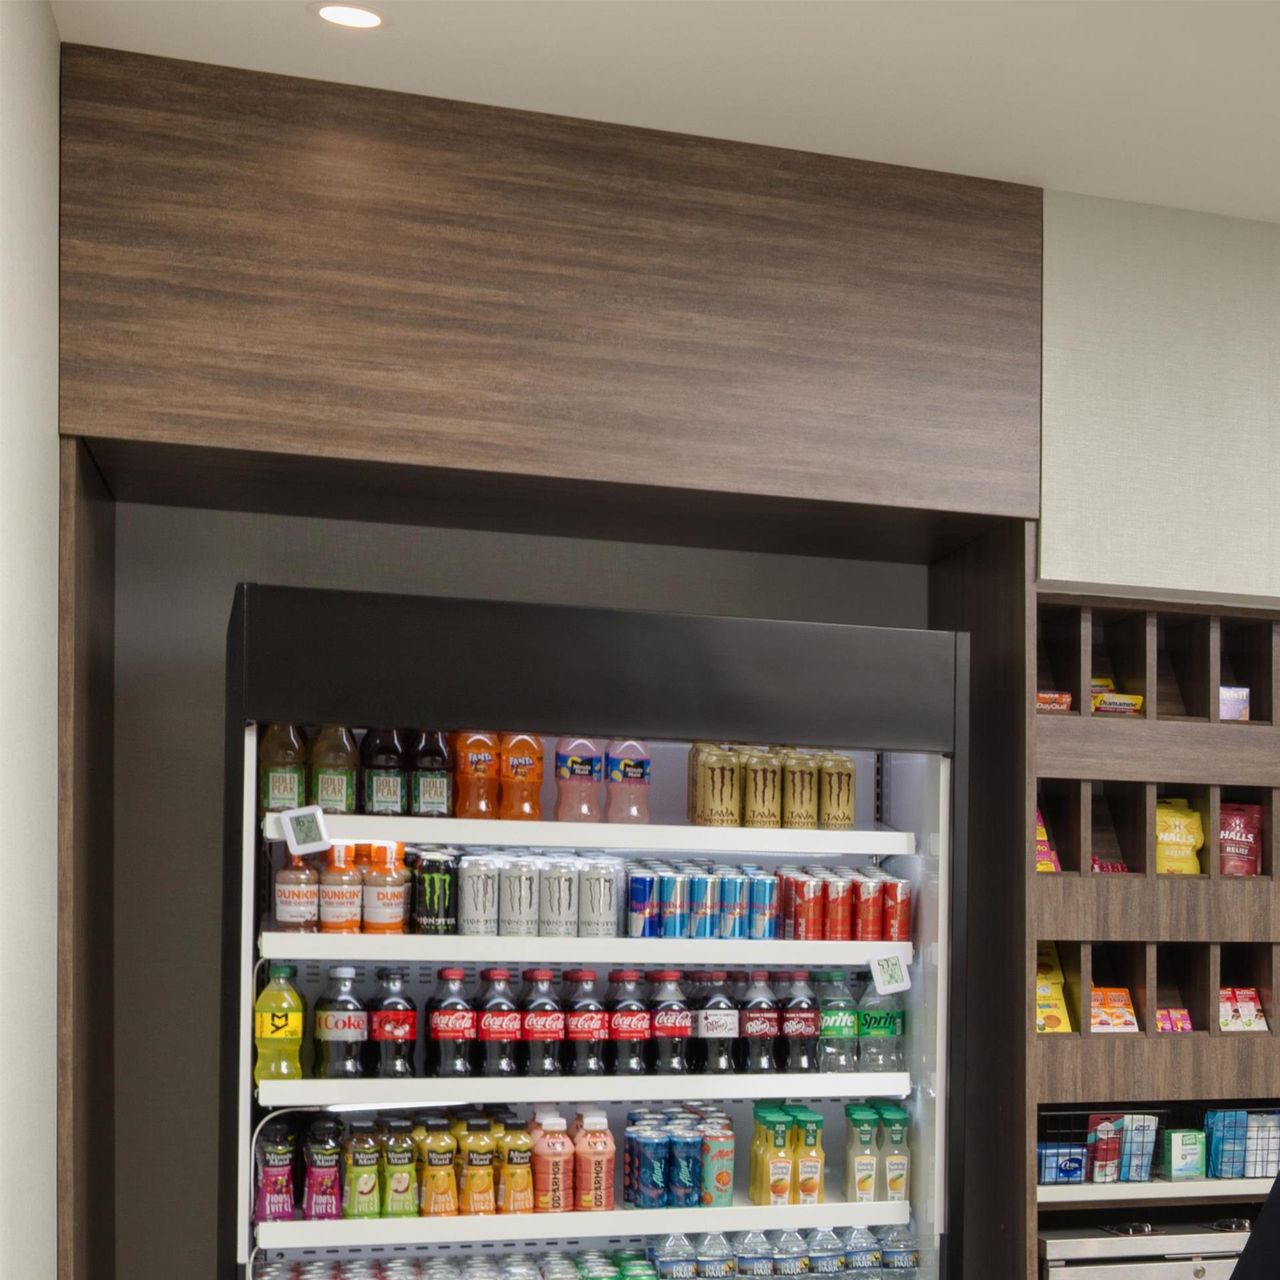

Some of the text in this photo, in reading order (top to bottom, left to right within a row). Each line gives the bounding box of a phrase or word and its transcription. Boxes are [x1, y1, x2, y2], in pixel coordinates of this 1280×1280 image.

[1100, 700, 1137, 708] Dramamine
[1159, 832, 1195, 843] HALLS
[1220, 831, 1255, 843] HALLS
[1226, 847, 1249, 855] RELIEF
[325, 1014, 365, 1030] Coke
